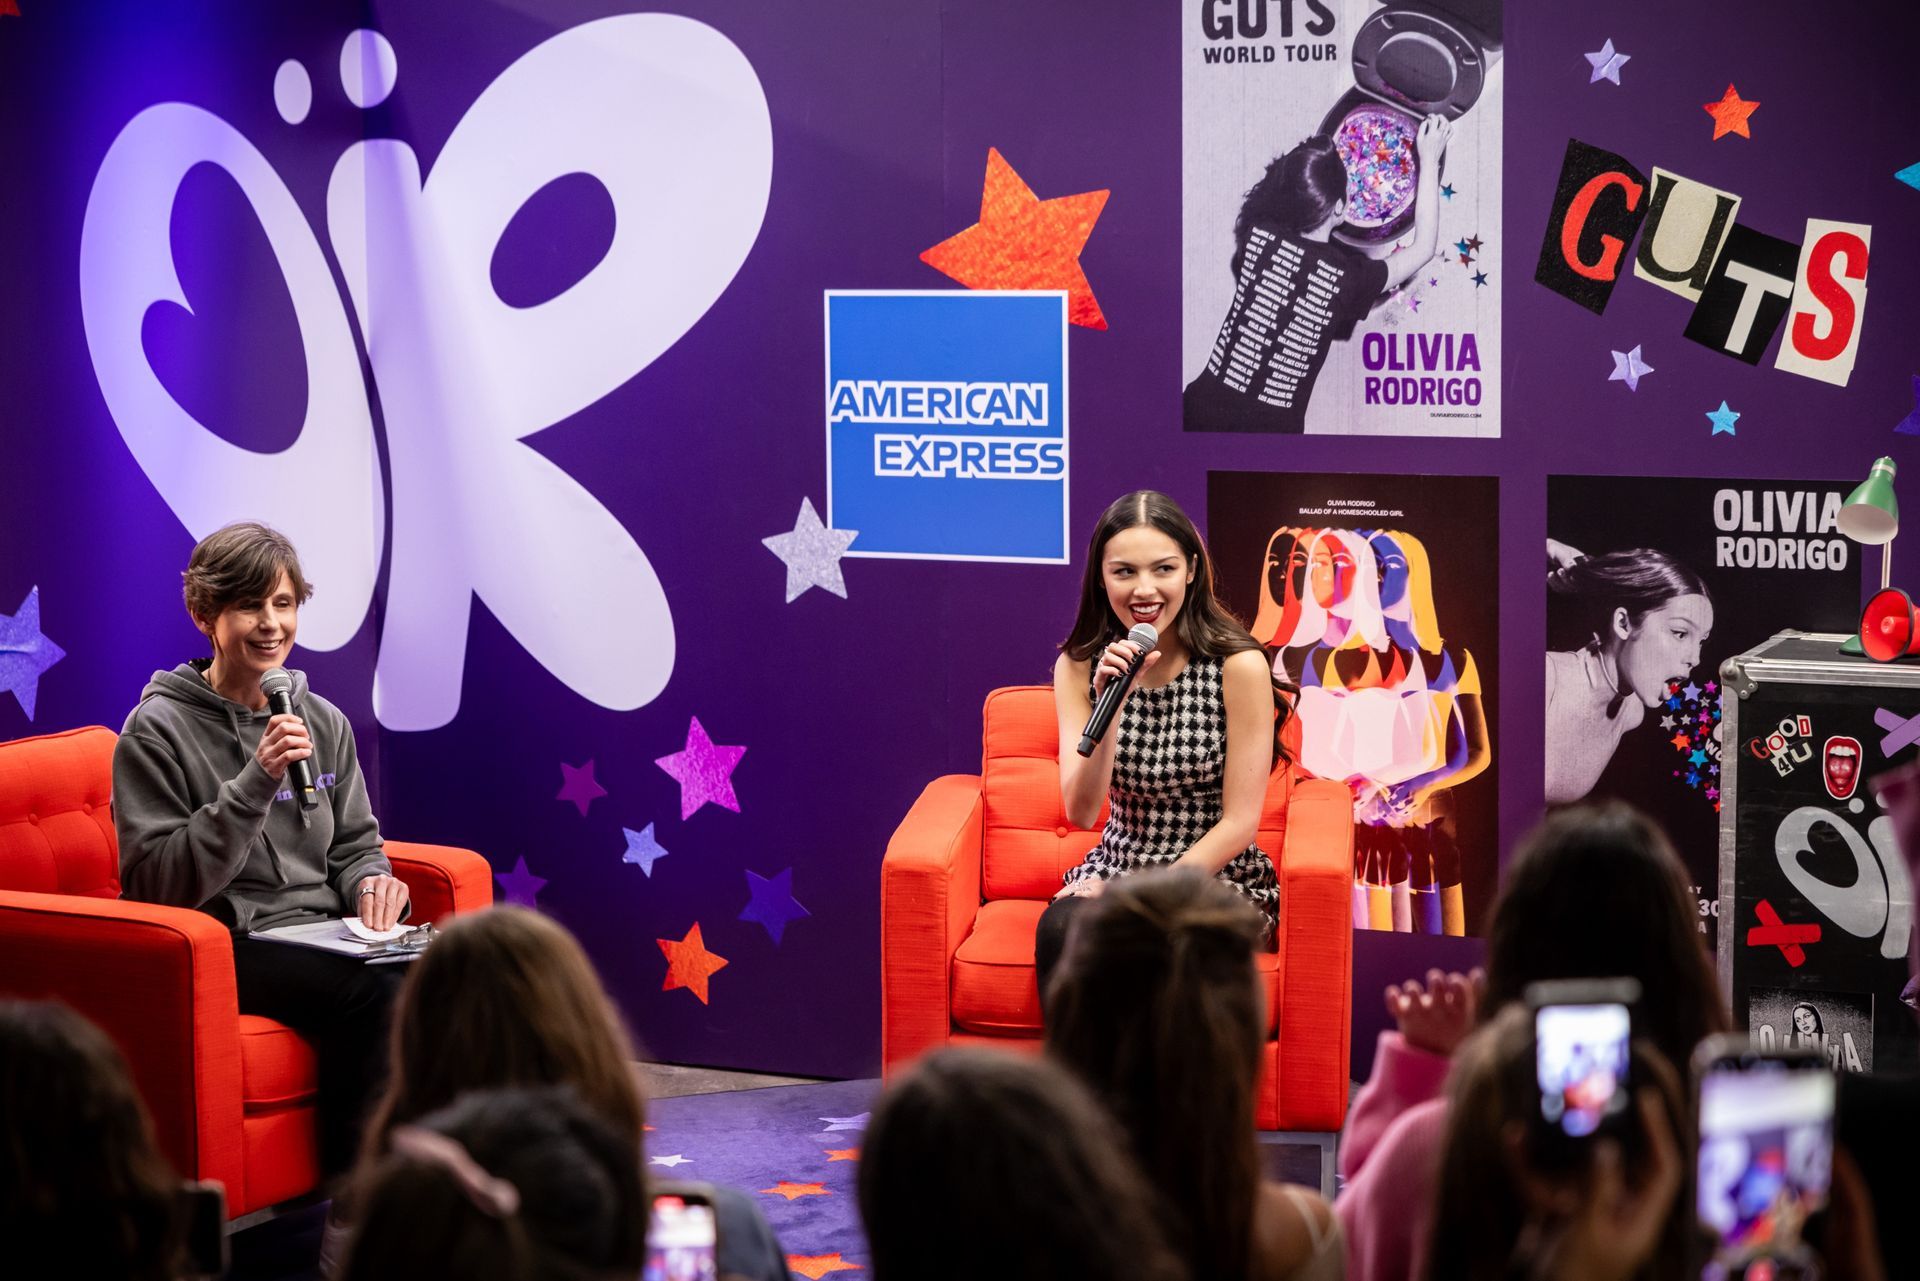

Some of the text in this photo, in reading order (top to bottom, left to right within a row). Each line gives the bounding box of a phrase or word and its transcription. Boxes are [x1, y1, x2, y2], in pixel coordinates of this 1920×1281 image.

[1202, 0, 1335, 40] GUTS
[1203, 44, 1337, 64] WORLD TOUR
[1562, 171, 1869, 361] GUTS
[1362, 332, 1481, 371] OLIVIA
[831, 383, 1046, 423] AMERICAN
[1365, 377, 1481, 406] RODRIGO
[877, 437, 1065, 477] EXPRESS
[1713, 489, 1848, 534] OLIVIA
[1716, 536, 1848, 571] RODRIGO
